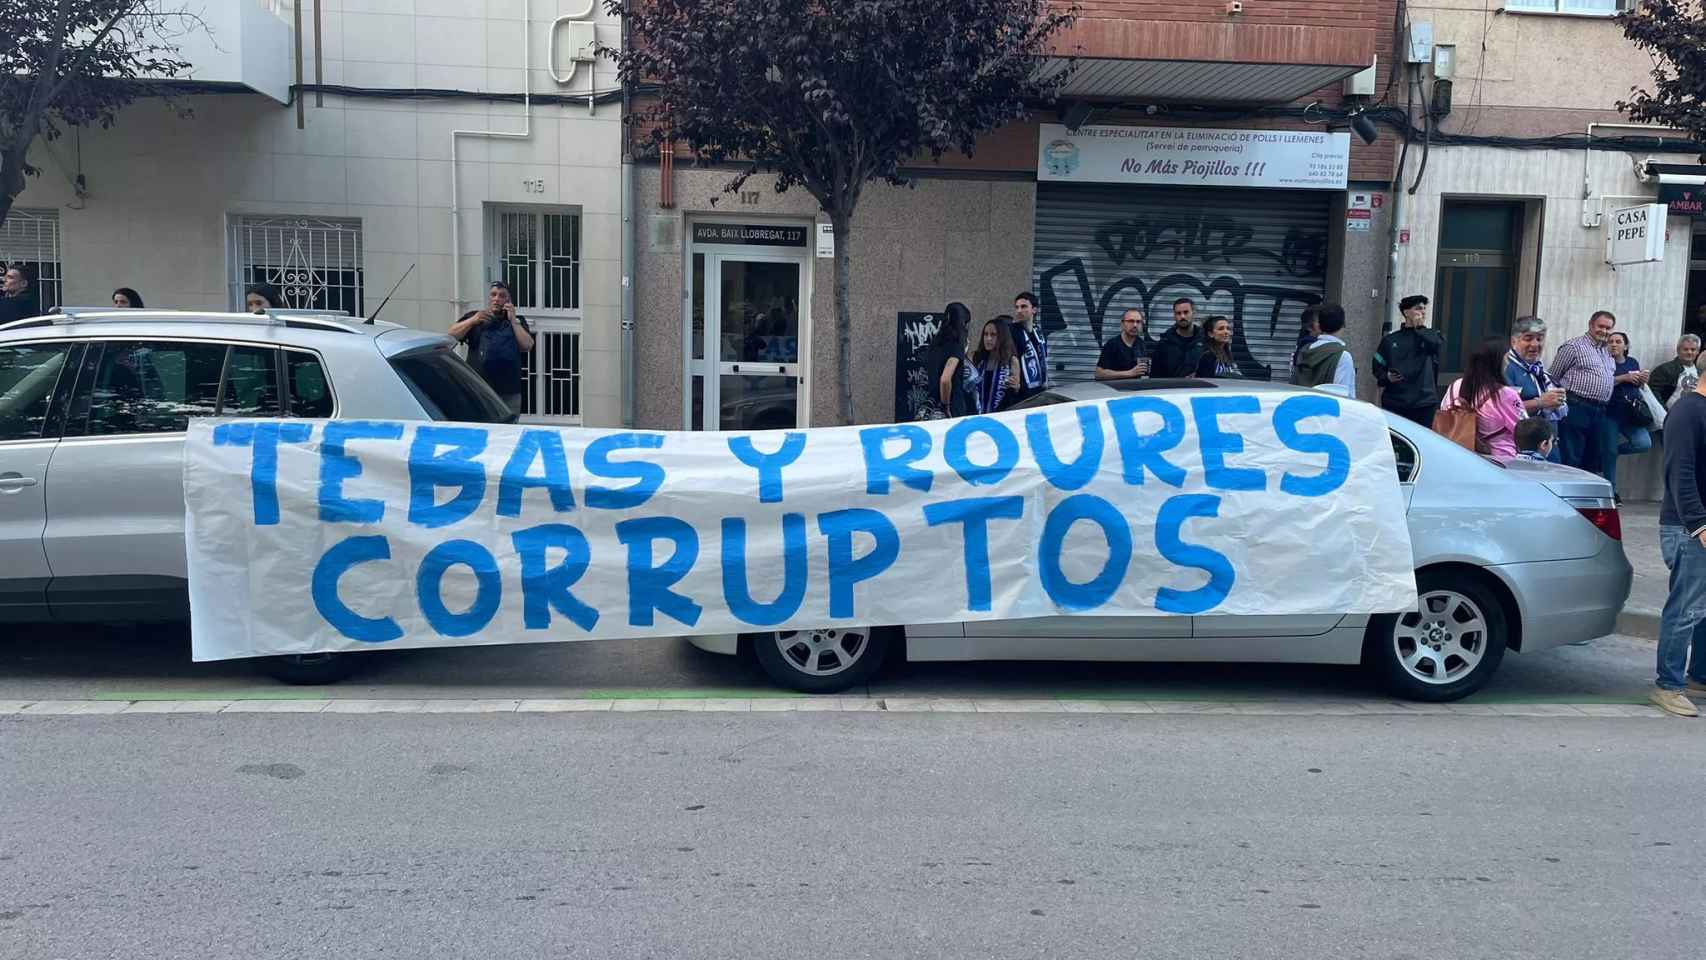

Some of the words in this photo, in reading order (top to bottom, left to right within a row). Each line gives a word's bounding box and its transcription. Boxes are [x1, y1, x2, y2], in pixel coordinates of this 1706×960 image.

[1160, 131, 1172, 139] EN
[1174, 132, 1184, 140] LA
[1240, 133, 1250, 142] DE
[1252, 134, 1277, 143] POLLS
[1284, 135, 1325, 144] LLEMENES
[1146, 142, 1175, 151] (Servei
[1177, 143, 1189, 151] de
[1120, 158, 1142, 173] No
[1145, 159, 1178, 174] Más
[1182, 159, 1240, 179] Piojillos
[1244, 161, 1267, 176] !!!
[523, 179, 545, 193] 115
[741, 191, 760, 204] 117
[1669, 200, 1703, 211] AMBAR
[1617, 210, 1647, 225] CASA
[697, 228, 719, 239] AVDA.
[721, 229, 739, 239] BAIX
[740, 229, 785, 241] LLOBREGAT,
[786, 231, 801, 241] 117
[1617, 227, 1646, 241] PEPE
[213, 420, 666, 529] TEBAS
[727, 431, 806, 503] Y
[858, 393, 1352, 497] ROURES
[310, 492, 1238, 645] CORRUPTOS
